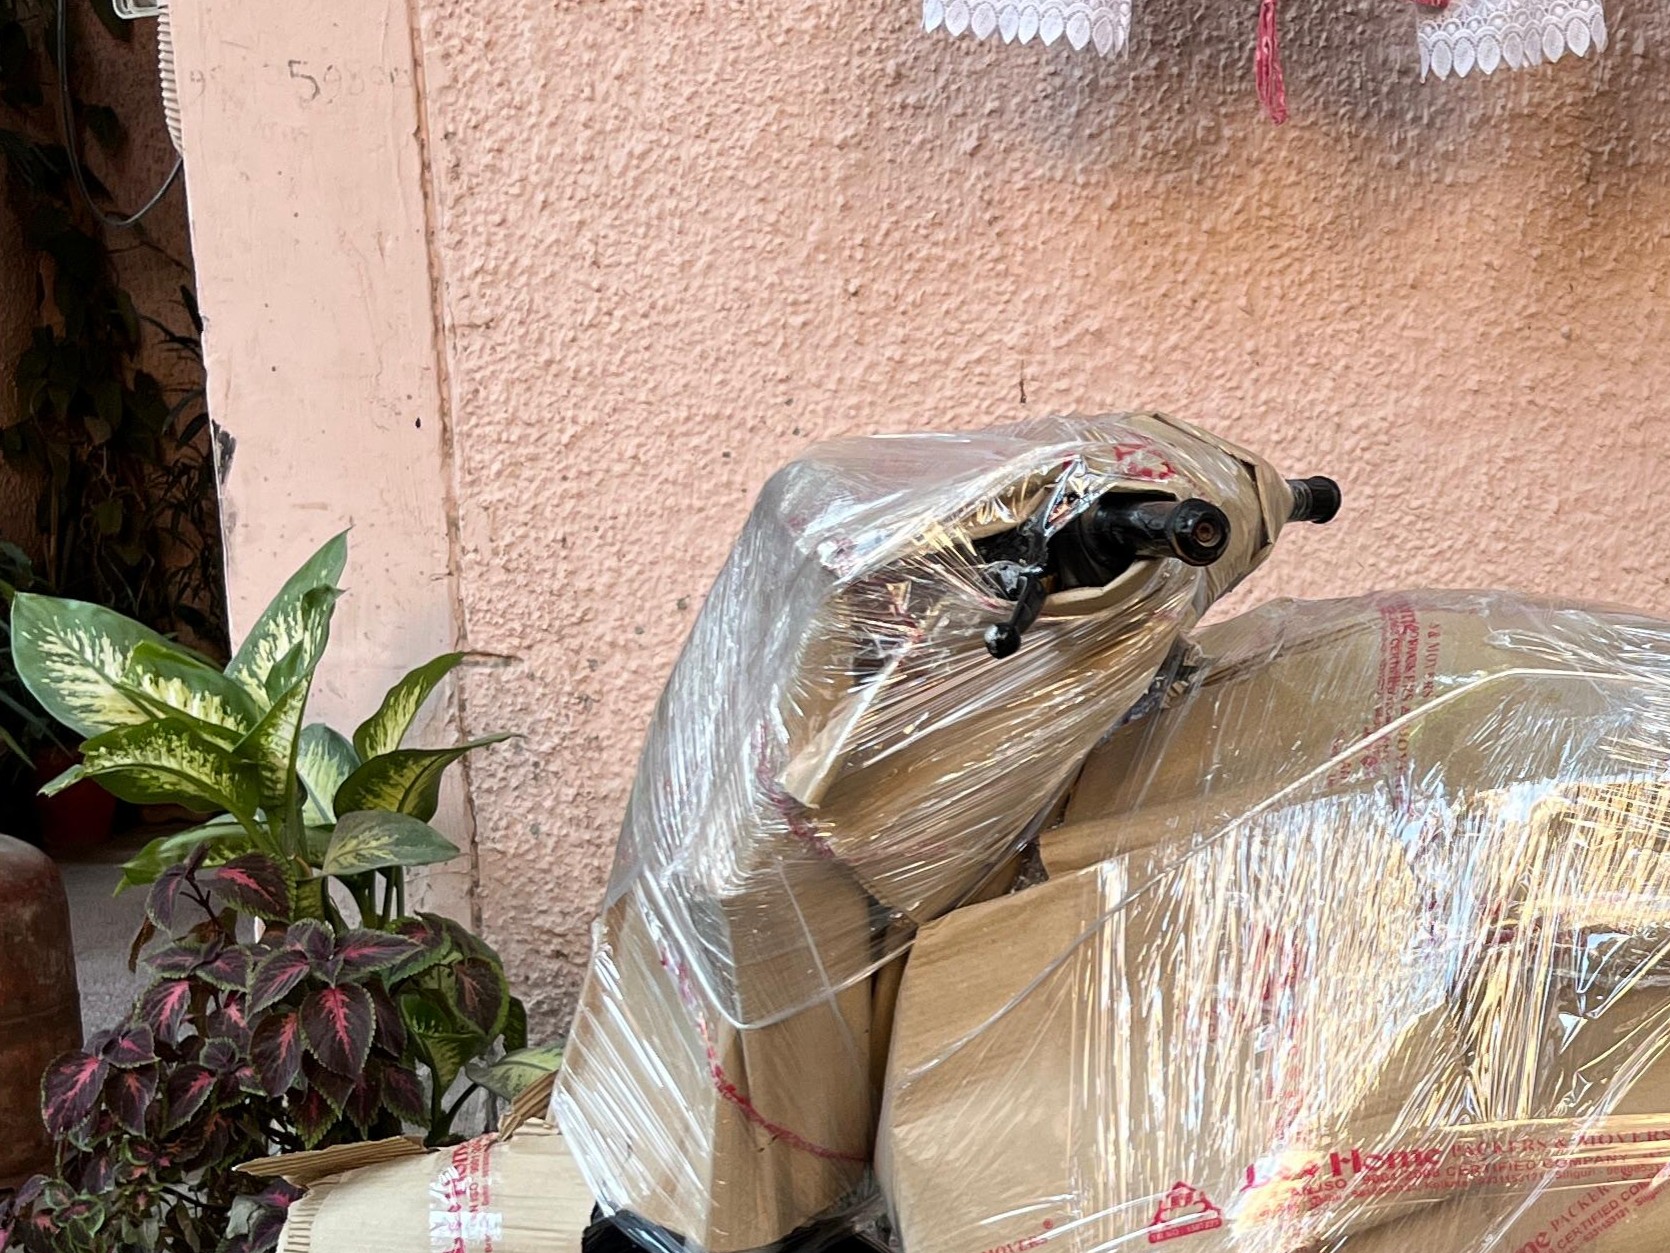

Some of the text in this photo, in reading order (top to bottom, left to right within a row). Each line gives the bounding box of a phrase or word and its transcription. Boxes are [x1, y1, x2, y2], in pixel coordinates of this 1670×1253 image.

[1329, 1148, 1442, 1177] Home
[1549, 1185, 1611, 1232] PACKER
[1556, 1198, 1620, 1250] CERTIFIED
